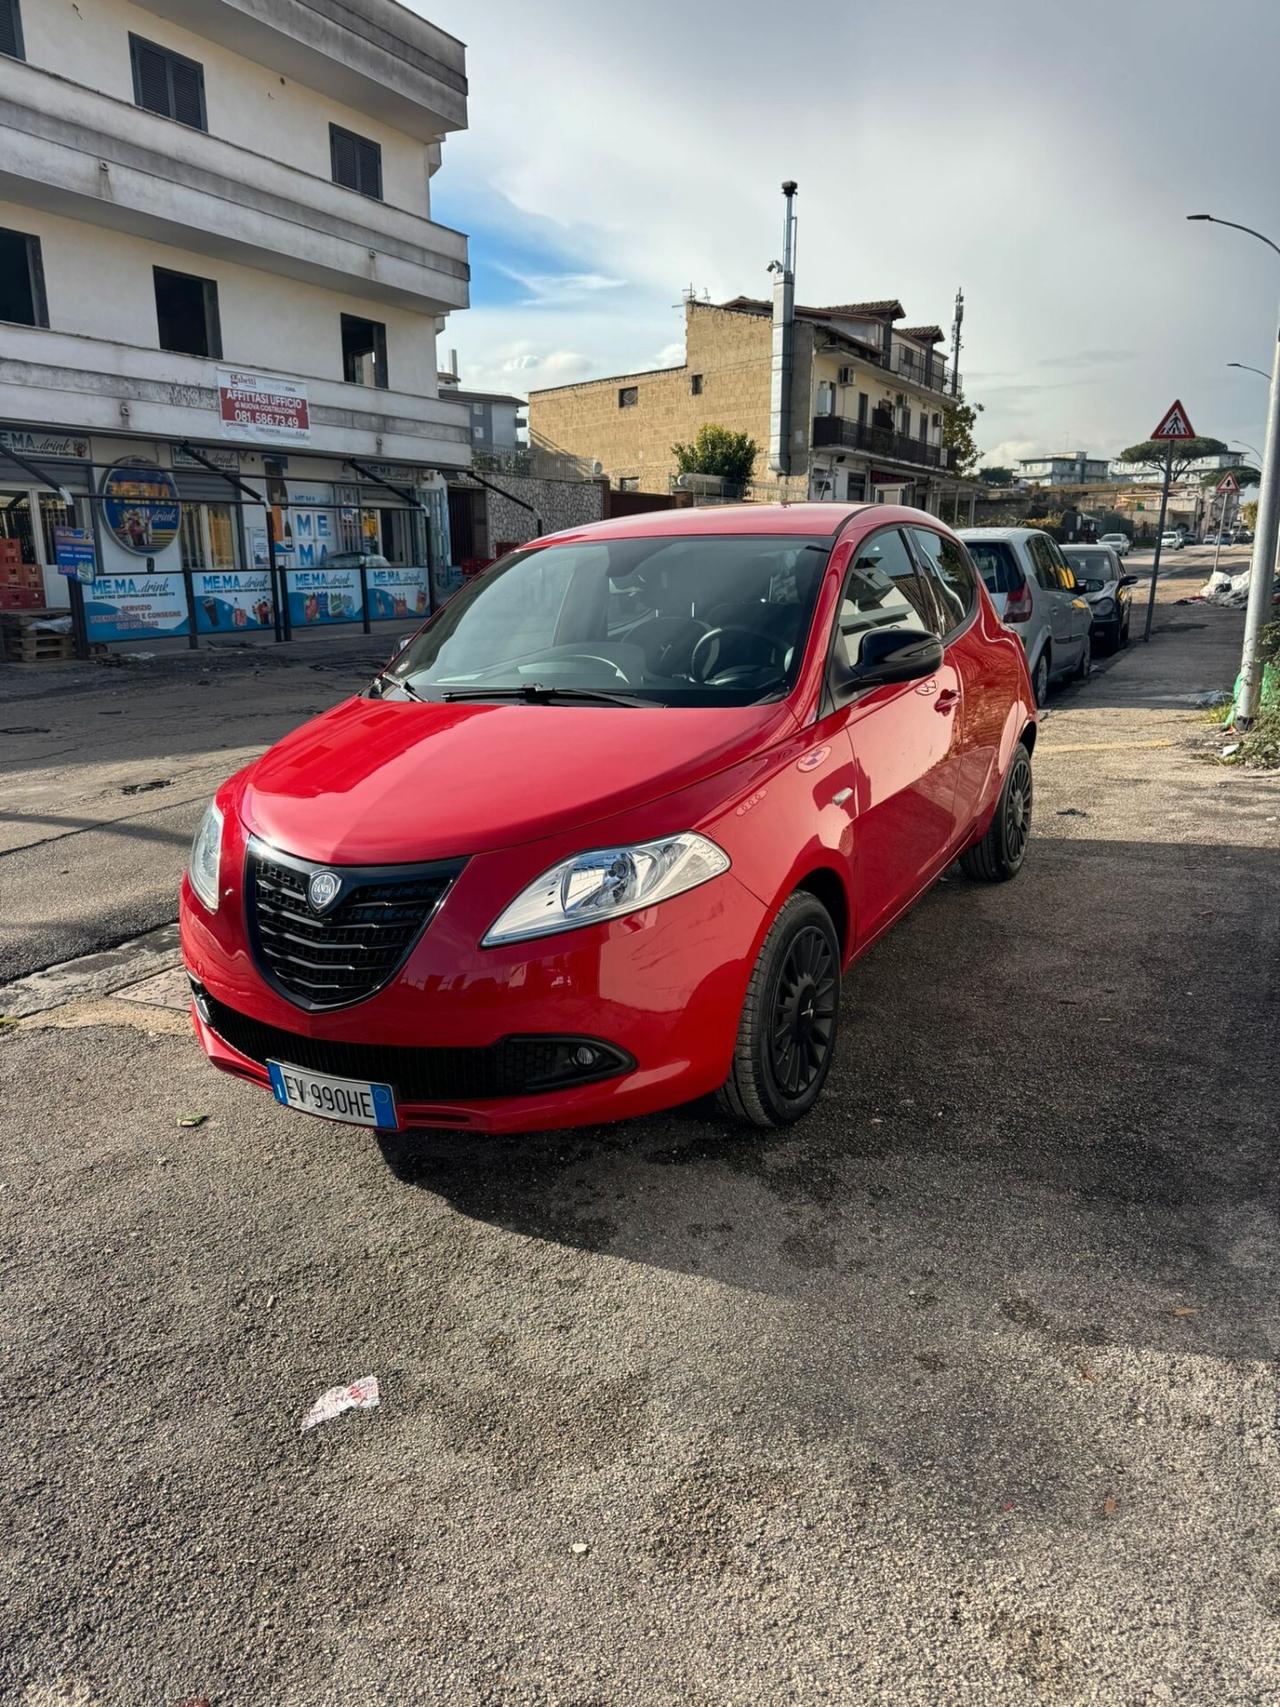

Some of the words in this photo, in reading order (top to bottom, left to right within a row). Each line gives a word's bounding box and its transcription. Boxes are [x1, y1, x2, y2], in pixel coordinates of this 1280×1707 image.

[226, 389, 269, 405] AFFITTASI
[270, 395, 303, 409] UFFICIO
[241, 402, 260, 410] NUOVA
[260, 405, 297, 416] COSTRUZIONE
[283, 1074, 305, 1103] EV
[310, 1082, 375, 1119] 990HE
